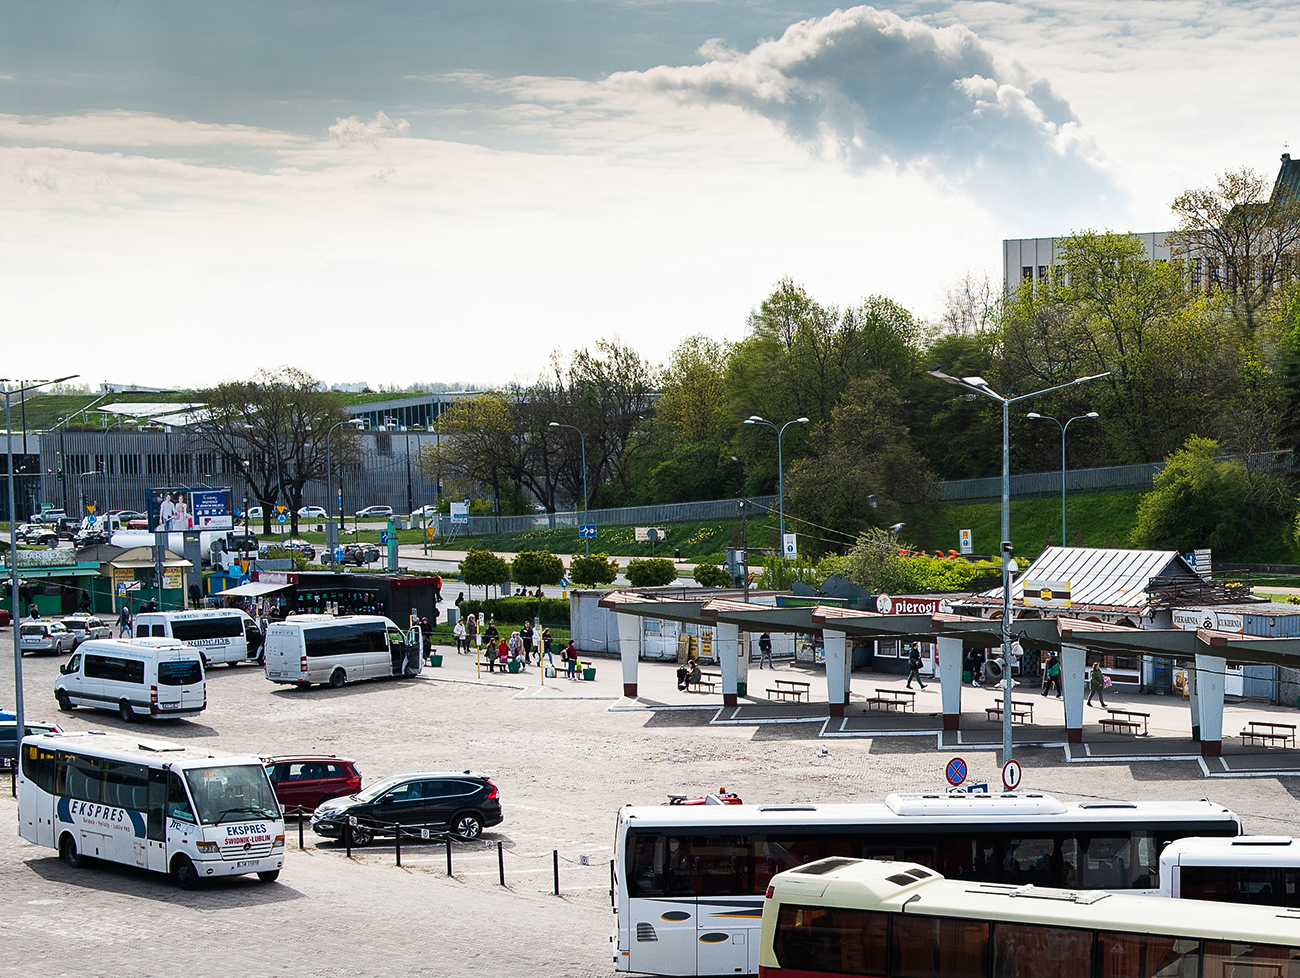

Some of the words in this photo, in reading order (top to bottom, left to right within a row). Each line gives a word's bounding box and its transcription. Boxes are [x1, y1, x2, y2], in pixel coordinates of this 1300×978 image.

[895, 600, 936, 615] pierogi
[1174, 615, 1199, 625] PIEKARNIA
[1218, 618, 1242, 628] CUKIERNIA
[1211, 683, 1216, 691] 5
[71, 801, 125, 823] EKSPRES
[226, 824, 267, 836] EKSPRES
